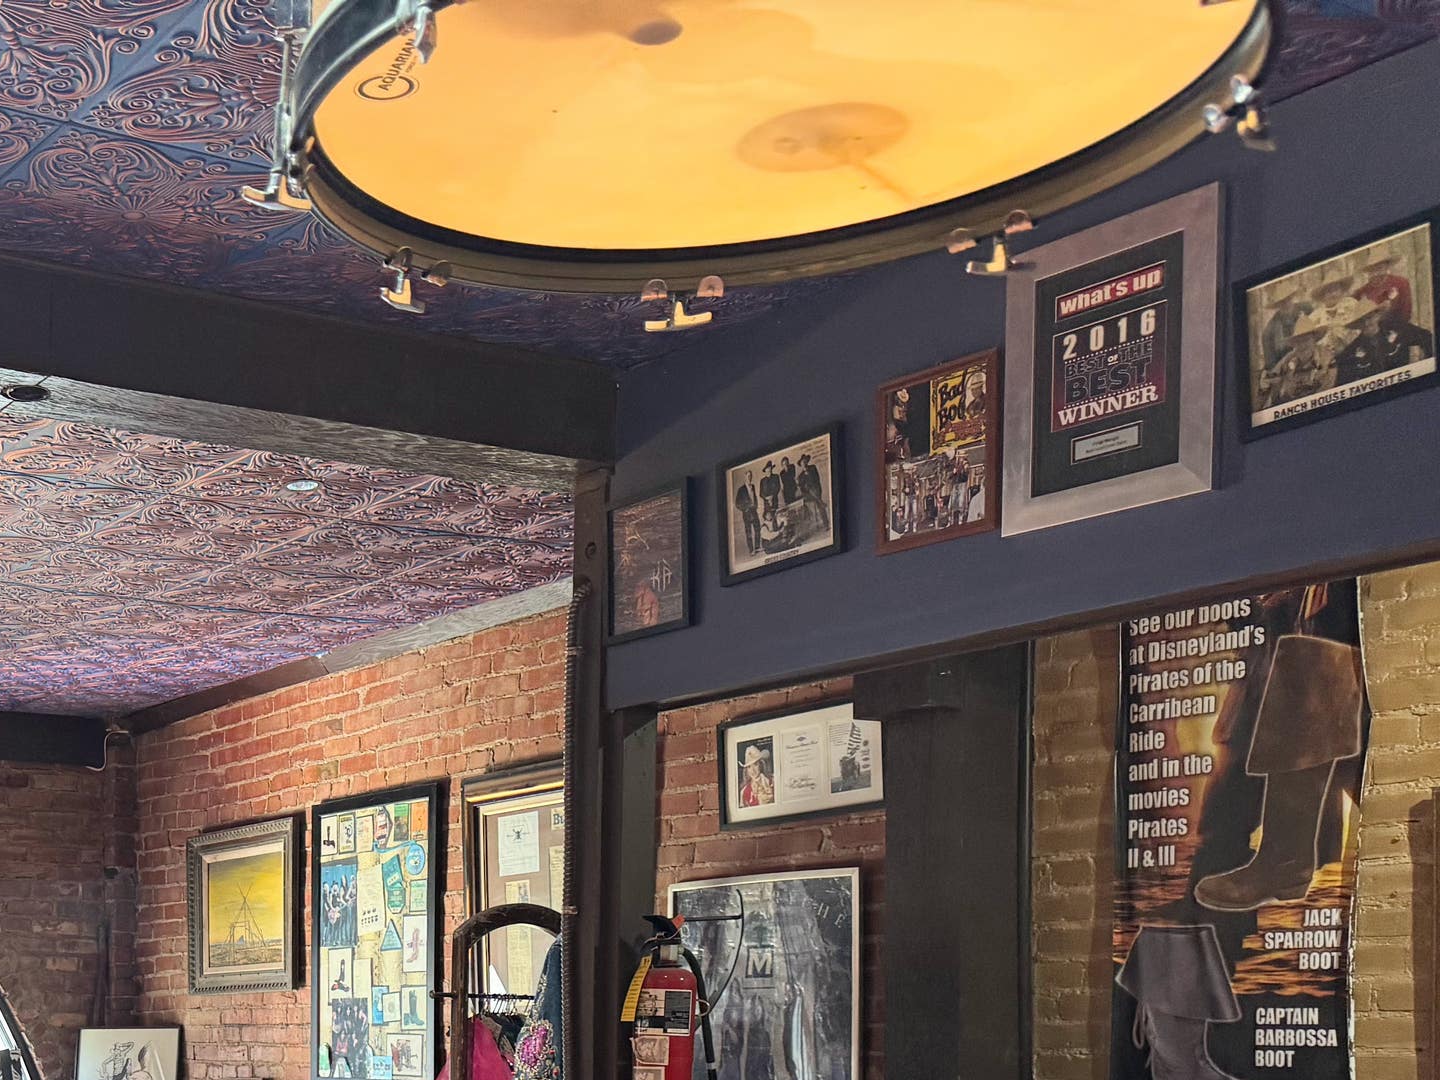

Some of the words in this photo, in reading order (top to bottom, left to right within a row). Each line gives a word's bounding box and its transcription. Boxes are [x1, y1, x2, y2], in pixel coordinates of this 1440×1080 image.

[378, 38, 415, 91] AQUARIAN
[1060, 281, 1129, 315] what's
[1133, 269, 1161, 291] up
[1065, 354, 1107, 379] BEST
[1118, 340, 1153, 361] THE
[1065, 358, 1150, 404] BEST
[1273, 402, 1308, 420] RANCH
[1310, 389, 1346, 409] HOUSE
[1349, 370, 1412, 397] FAVORITES
[1058, 385, 1159, 426] WINNER
[1129, 614, 1161, 636] See
[1164, 608, 1195, 629] our
[1129, 644, 1146, 666] at
[1148, 625, 1266, 664] Disneyland's
[1129, 667, 1190, 695] Pirates
[1193, 662, 1212, 685] of
[1215, 659, 1246, 681] the
[1129, 695, 1216, 724] Carribean
[1129, 730, 1166, 753] Ride
[1128, 760, 1159, 782] and
[1162, 758, 1179, 778] in
[1183, 754, 1213, 776] the
[1128, 786, 1190, 811] movies
[1127, 818, 1188, 840] Pirates
[1127, 848, 1139, 869] II
[1142, 848, 1155, 867] &
[1158, 845, 1176, 866] III
[1303, 908, 1343, 927] JACK
[1264, 930, 1342, 950] SPARROW
[1298, 952, 1342, 970] BOOT
[1255, 1007, 1319, 1025] CAPTAIN
[1255, 1029, 1338, 1047] BARBOSSA
[1254, 1050, 1295, 1068] BOOT
